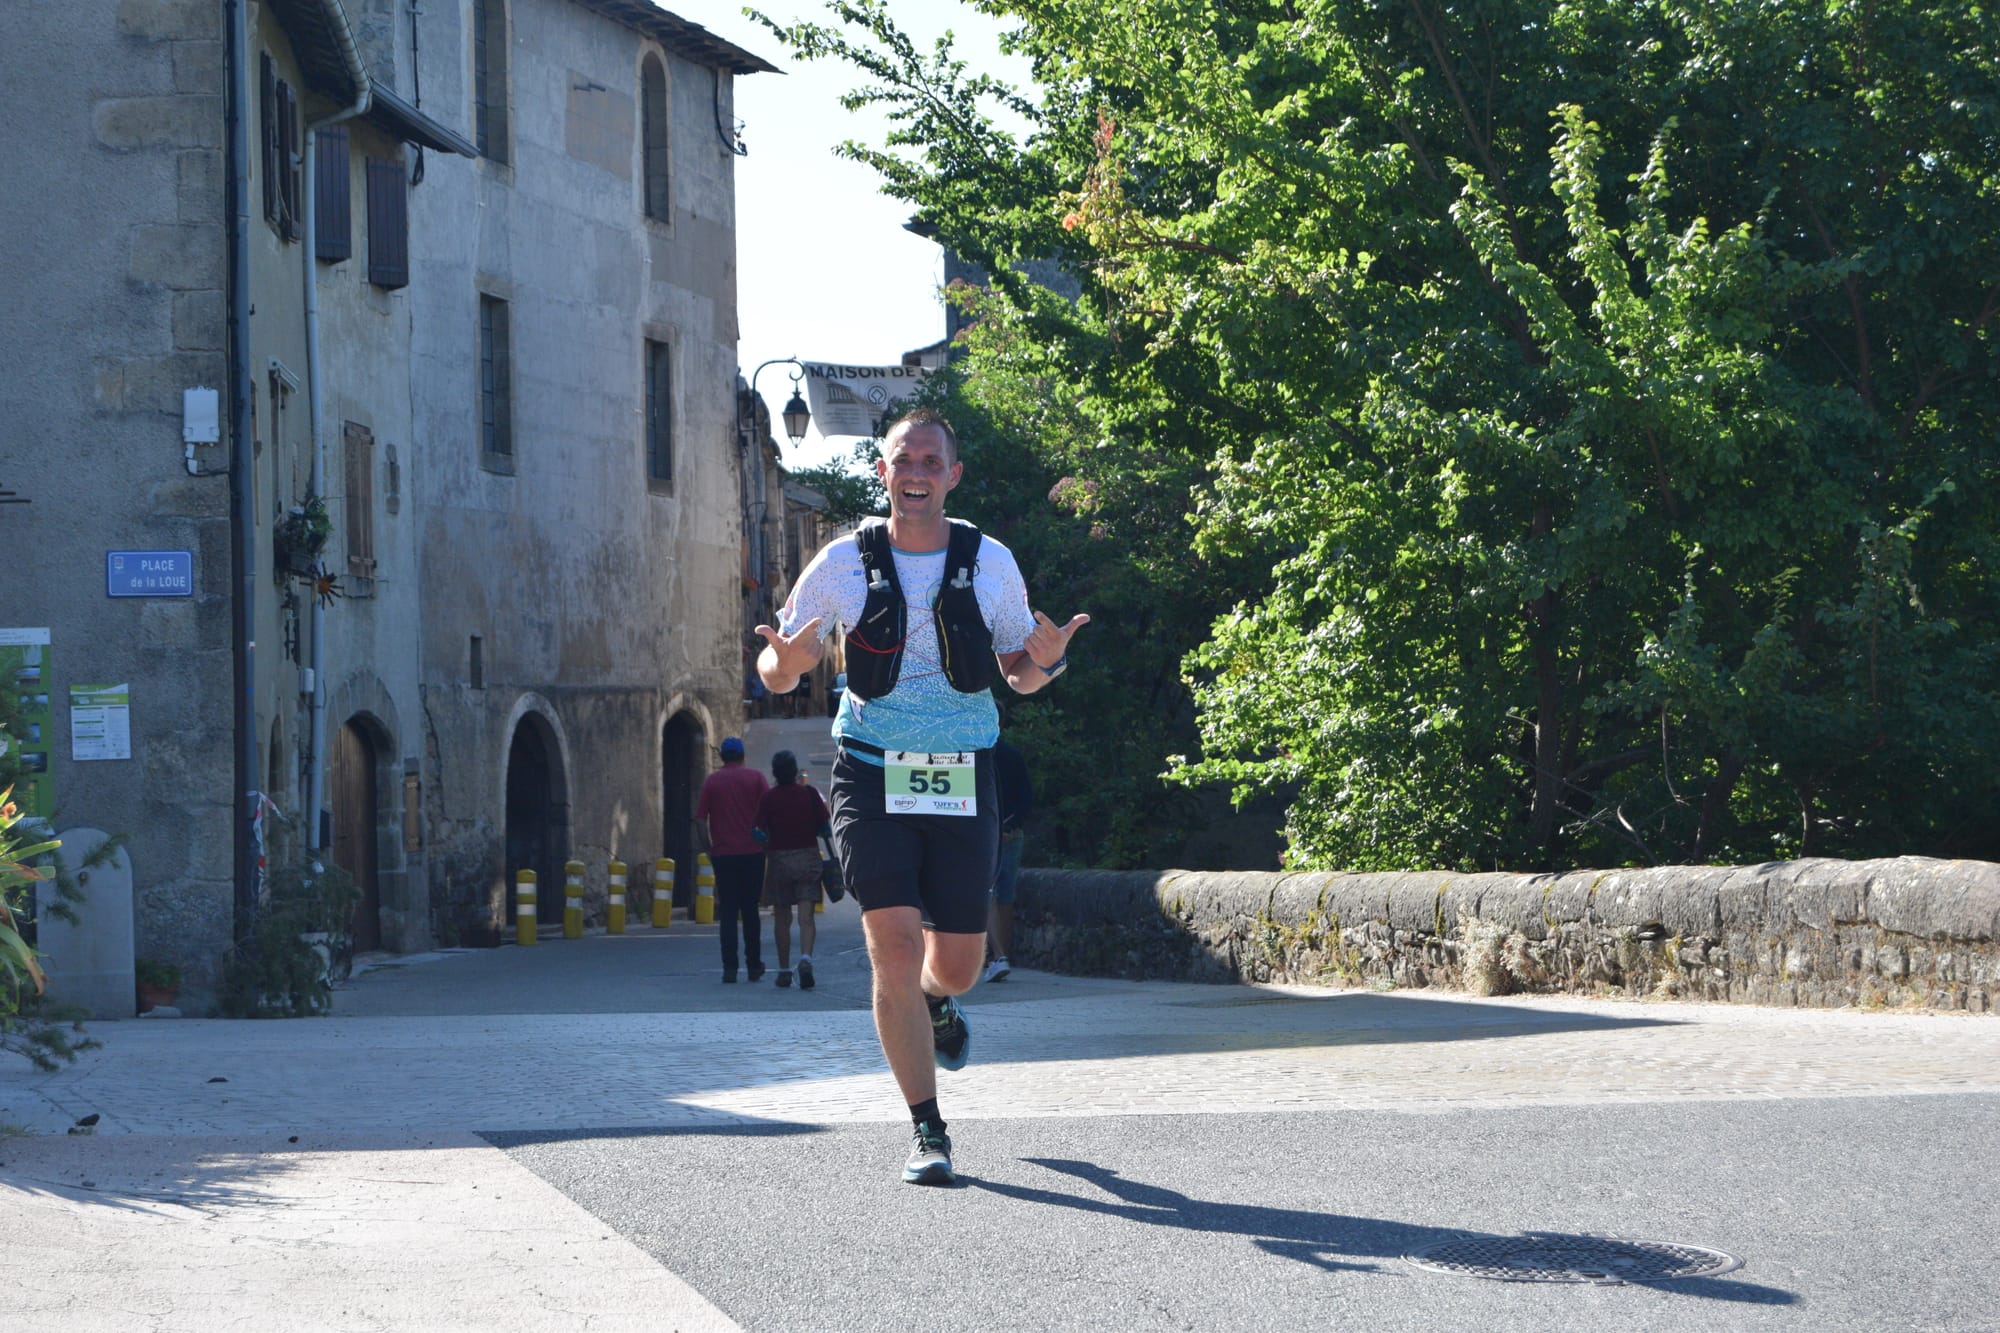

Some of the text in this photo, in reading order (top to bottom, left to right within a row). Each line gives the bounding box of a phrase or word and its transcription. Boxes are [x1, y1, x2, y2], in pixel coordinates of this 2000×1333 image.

[809, 365, 886, 379] MAISON
[892, 366, 916, 378] DE
[141, 559, 175, 571] PLACE
[130, 576, 187, 588] de la LOUE
[909, 769, 951, 795] 55
